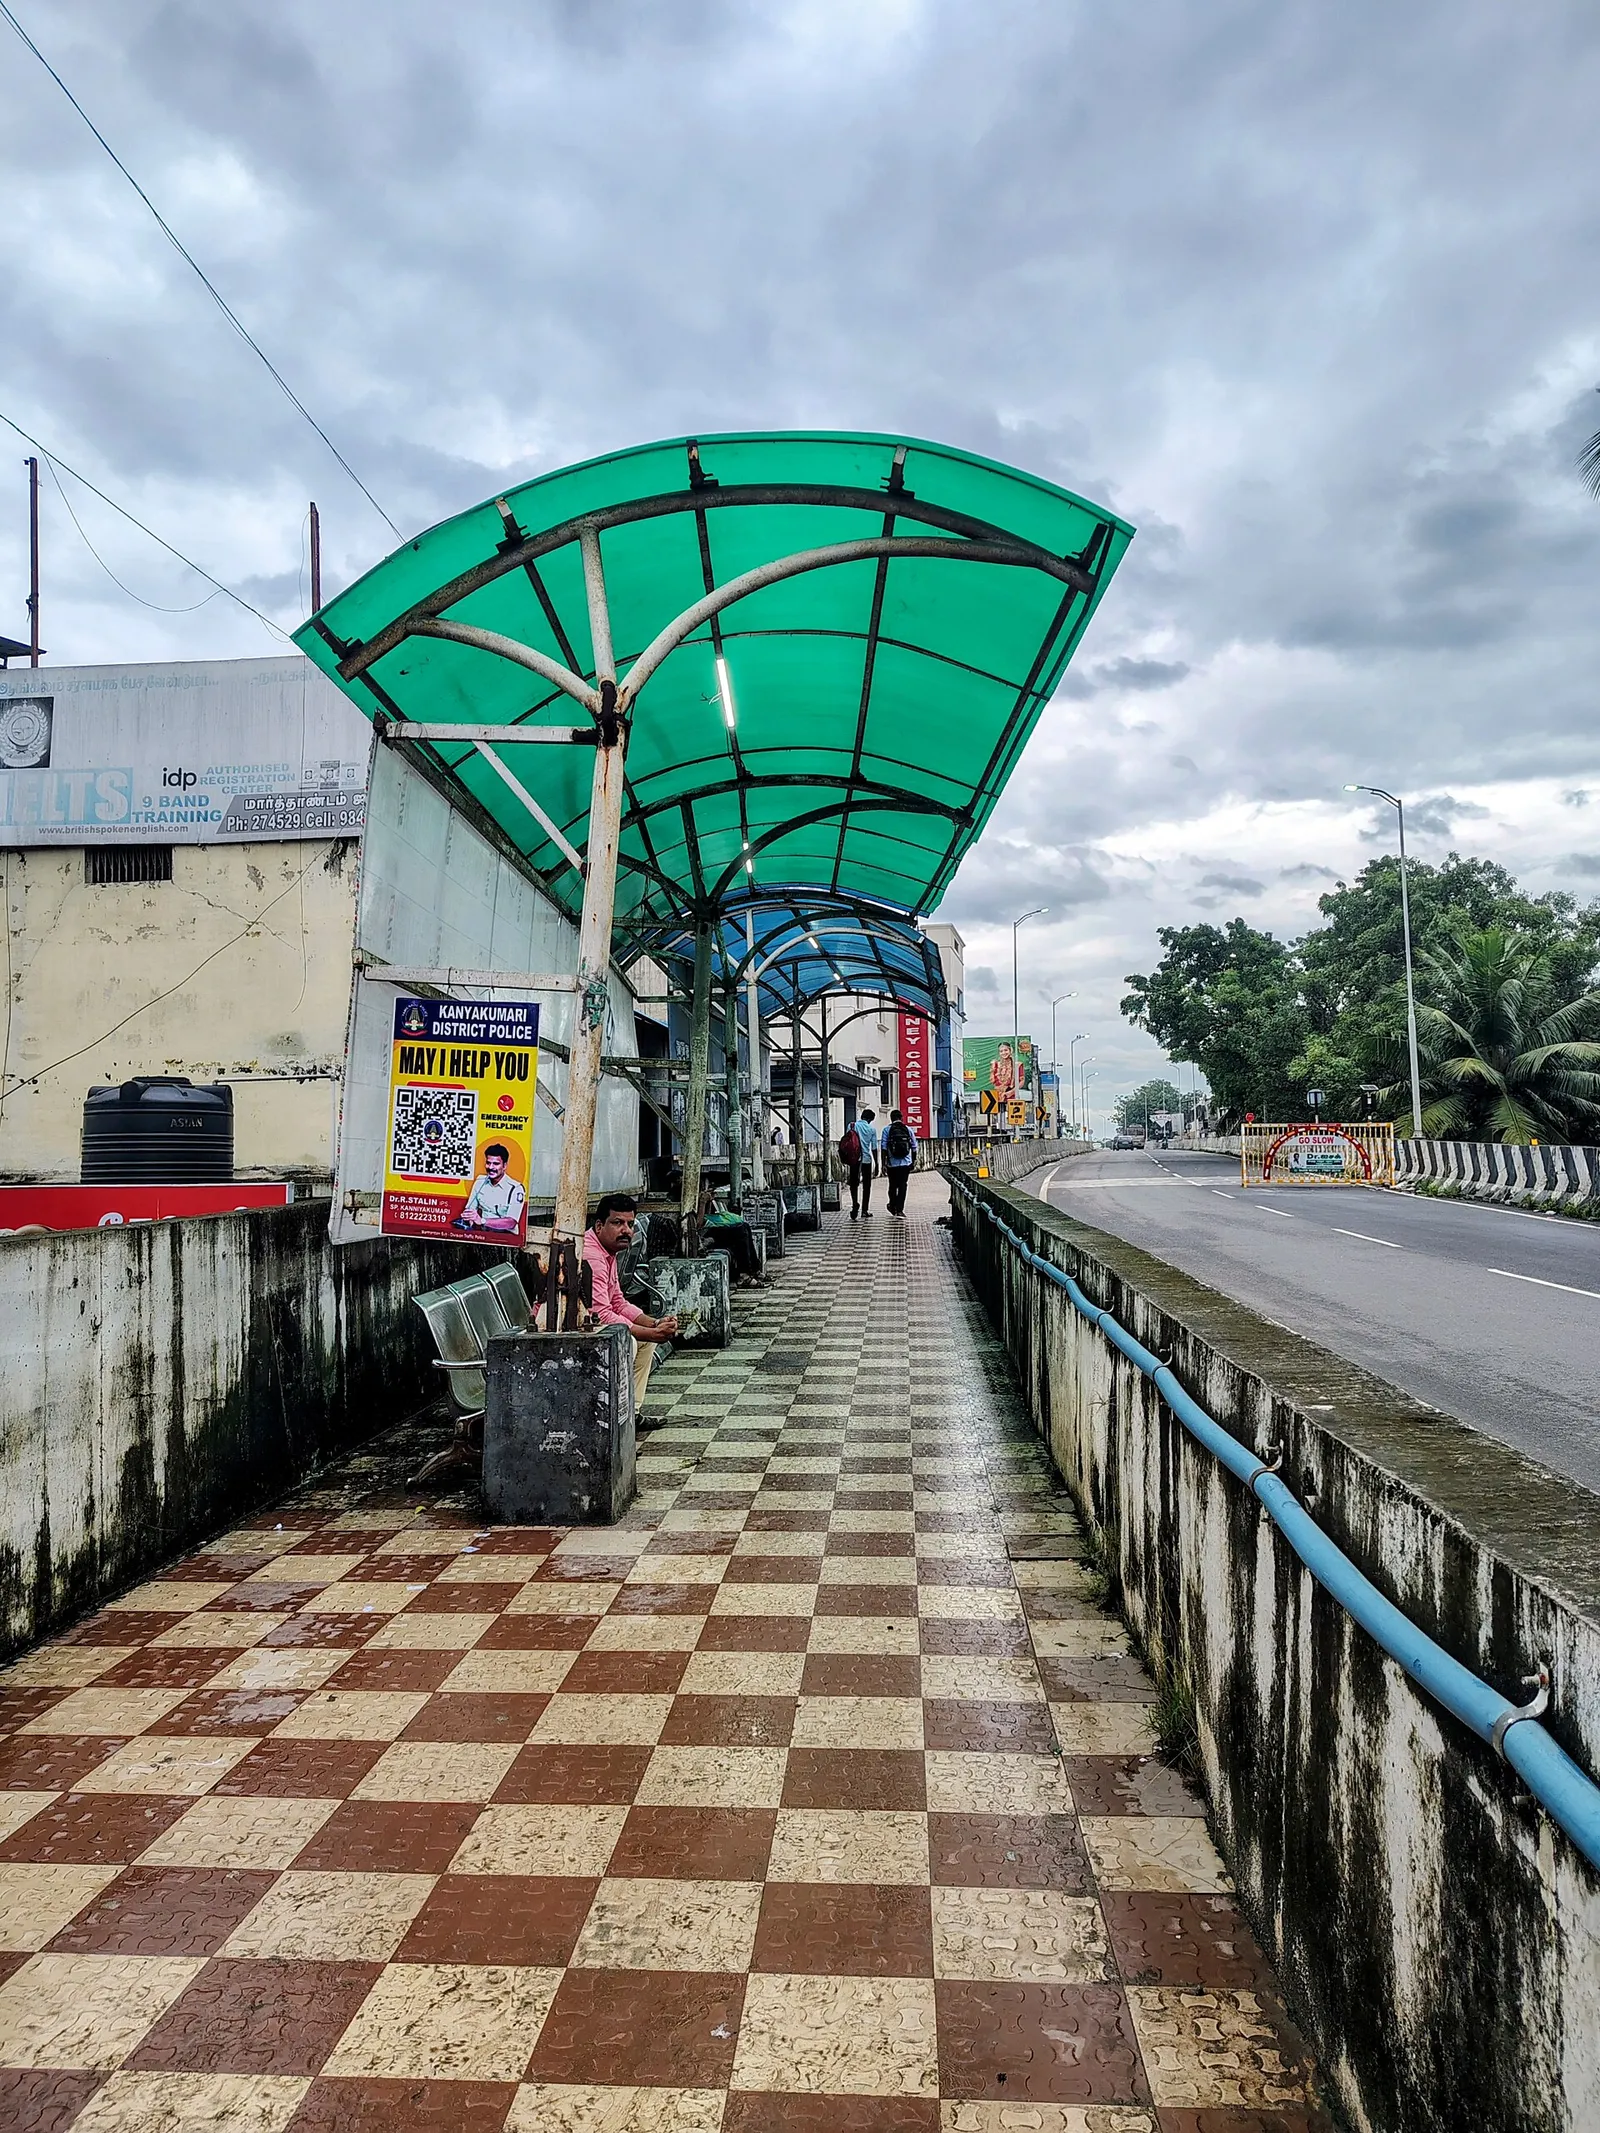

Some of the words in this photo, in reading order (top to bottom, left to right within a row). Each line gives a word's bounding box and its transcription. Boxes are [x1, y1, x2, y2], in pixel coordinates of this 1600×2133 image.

[206, 763, 290, 775] AUTHORISED
[162, 767, 197, 791] idp
[200, 773, 296, 785] REGISTRATION
[221, 784, 274, 794] CENTER
[142, 796, 153, 808] 9
[159, 795, 210, 807] BAND
[244, 791, 347, 812] மார்த்தாண்டம்
[131, 810, 222, 823] TRAINING
[226, 815, 249, 831] Ph:
[38, 823, 189, 835] www.britishspokenenglish.com
[439, 1005, 528, 1023] KANYAKUMARI
[432, 1021, 486, 1038] DISTRICT
[489, 1024, 532, 1040] POLICE
[905, 1016, 921, 1045] NEY
[399, 1046, 437, 1076] MAY
[439, 1048, 446, 1076] I
[449, 1049, 491, 1078] HELP
[495, 1052, 530, 1081] YOU
[905, 1051, 921, 1088] CARE
[481, 1113, 529, 1123] EMERGENCY
[907, 1096, 922, 1138] CENT
[485, 1122, 524, 1131] HELPLINE
[1299, 1136, 1310, 1144] GO
[1312, 1136, 1334, 1144] SLOW
[389, 1195, 438, 1206] Dr.R.STALIN
[400, 1204, 451, 1215] KANNIYAKUMARI
[399, 1211, 447, 1223] 8122223319
